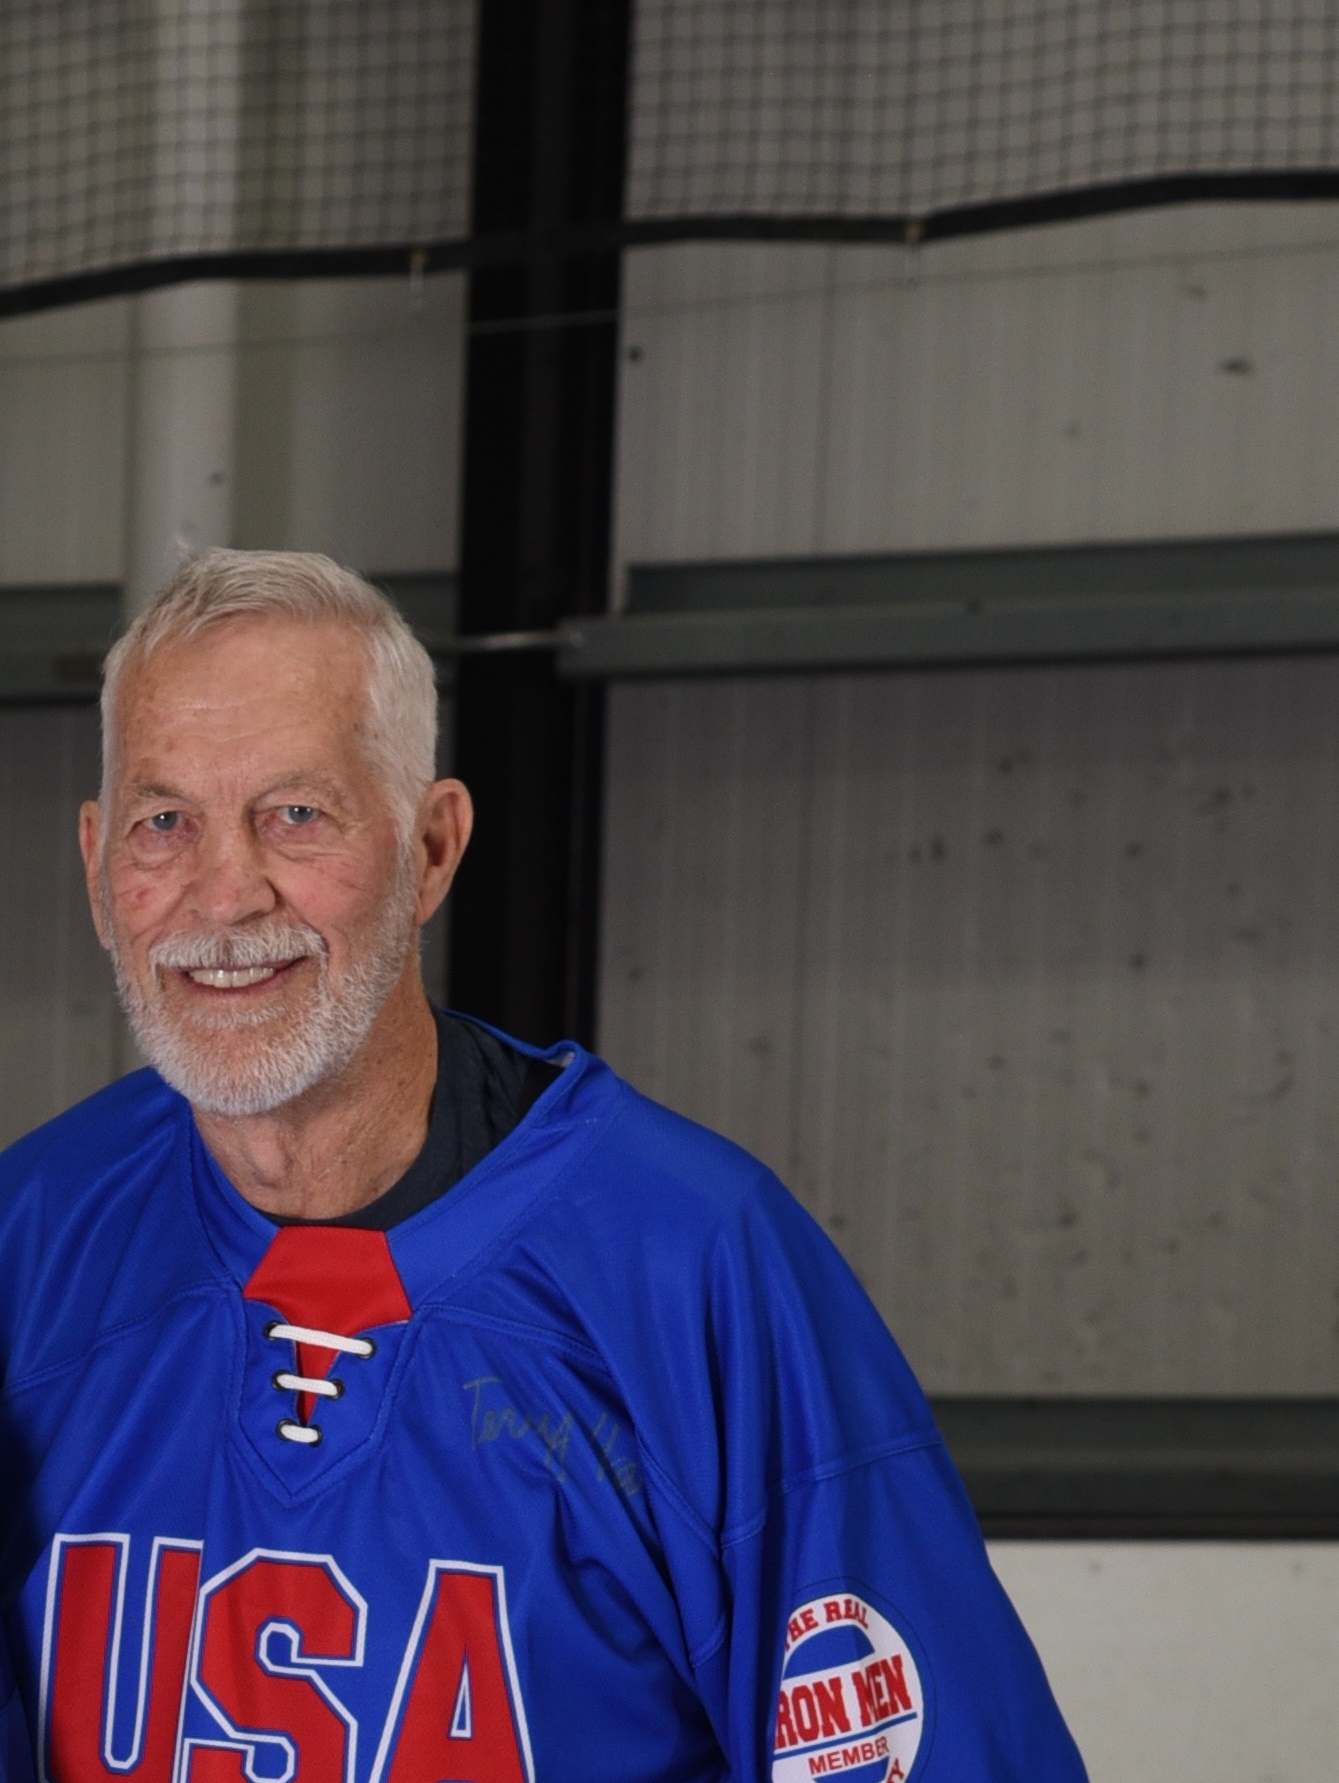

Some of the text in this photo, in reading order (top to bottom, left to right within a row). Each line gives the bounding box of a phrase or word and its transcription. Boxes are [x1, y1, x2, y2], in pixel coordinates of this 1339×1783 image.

[784, 1598, 869, 1652] HE REAL
[776, 1654, 913, 1750] RON MEN
[808, 1736, 890, 1775] MEMBER
